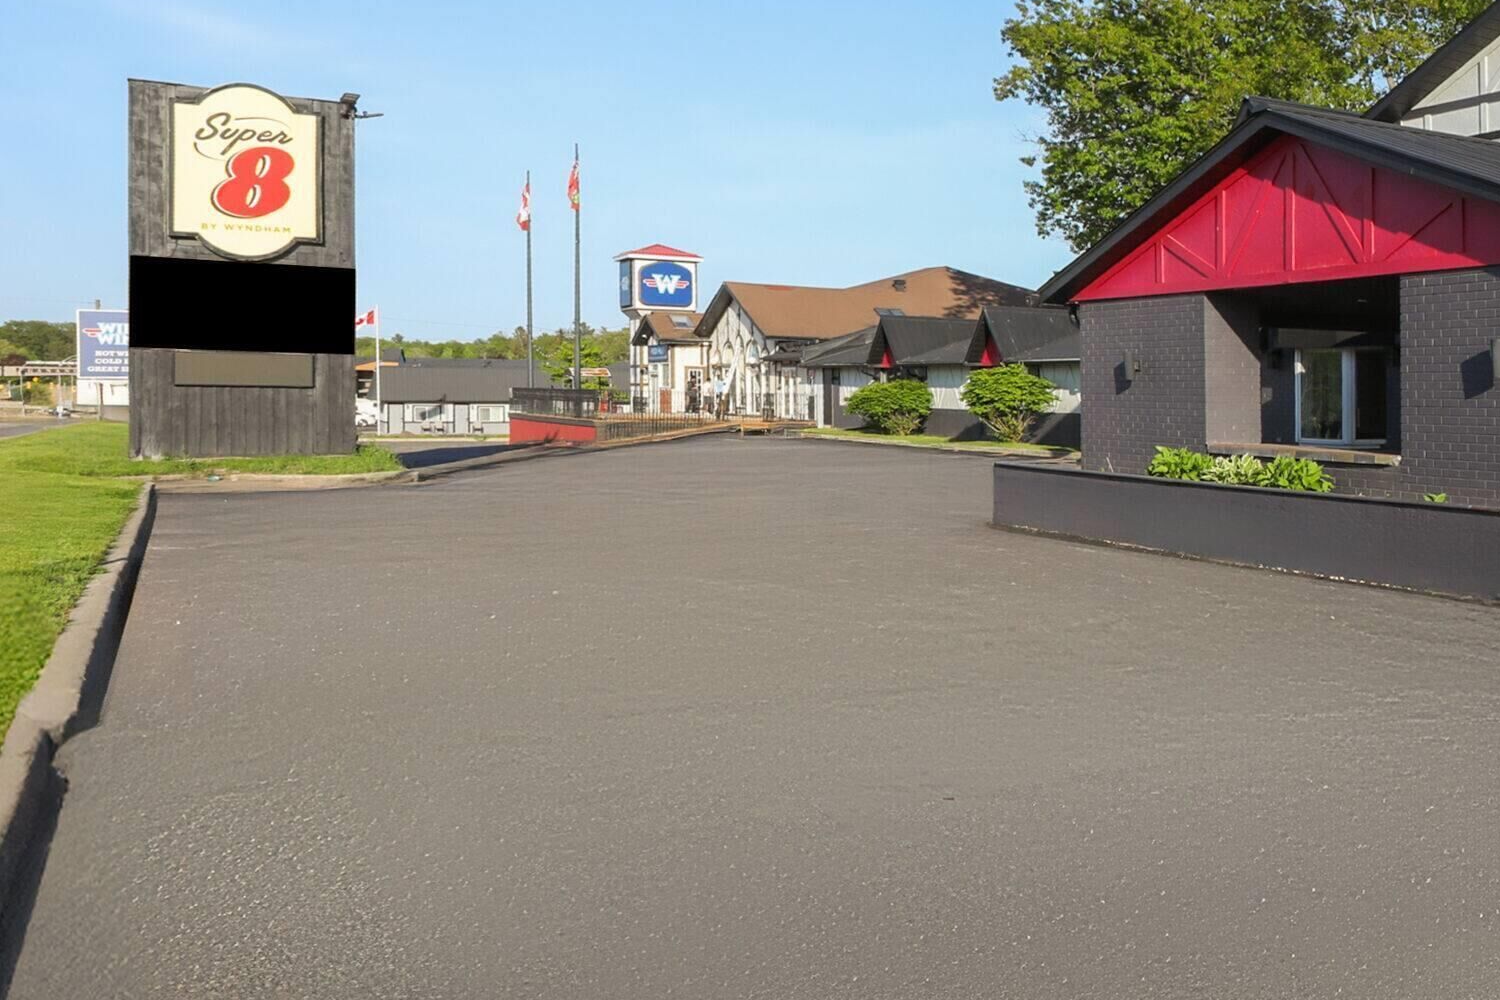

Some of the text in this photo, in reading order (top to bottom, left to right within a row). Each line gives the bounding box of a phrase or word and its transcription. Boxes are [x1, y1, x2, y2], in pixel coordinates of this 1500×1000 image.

[195, 112, 293, 156] Super
[211, 146, 295, 219] 8
[201, 222, 291, 233] BY WYNDHAM
